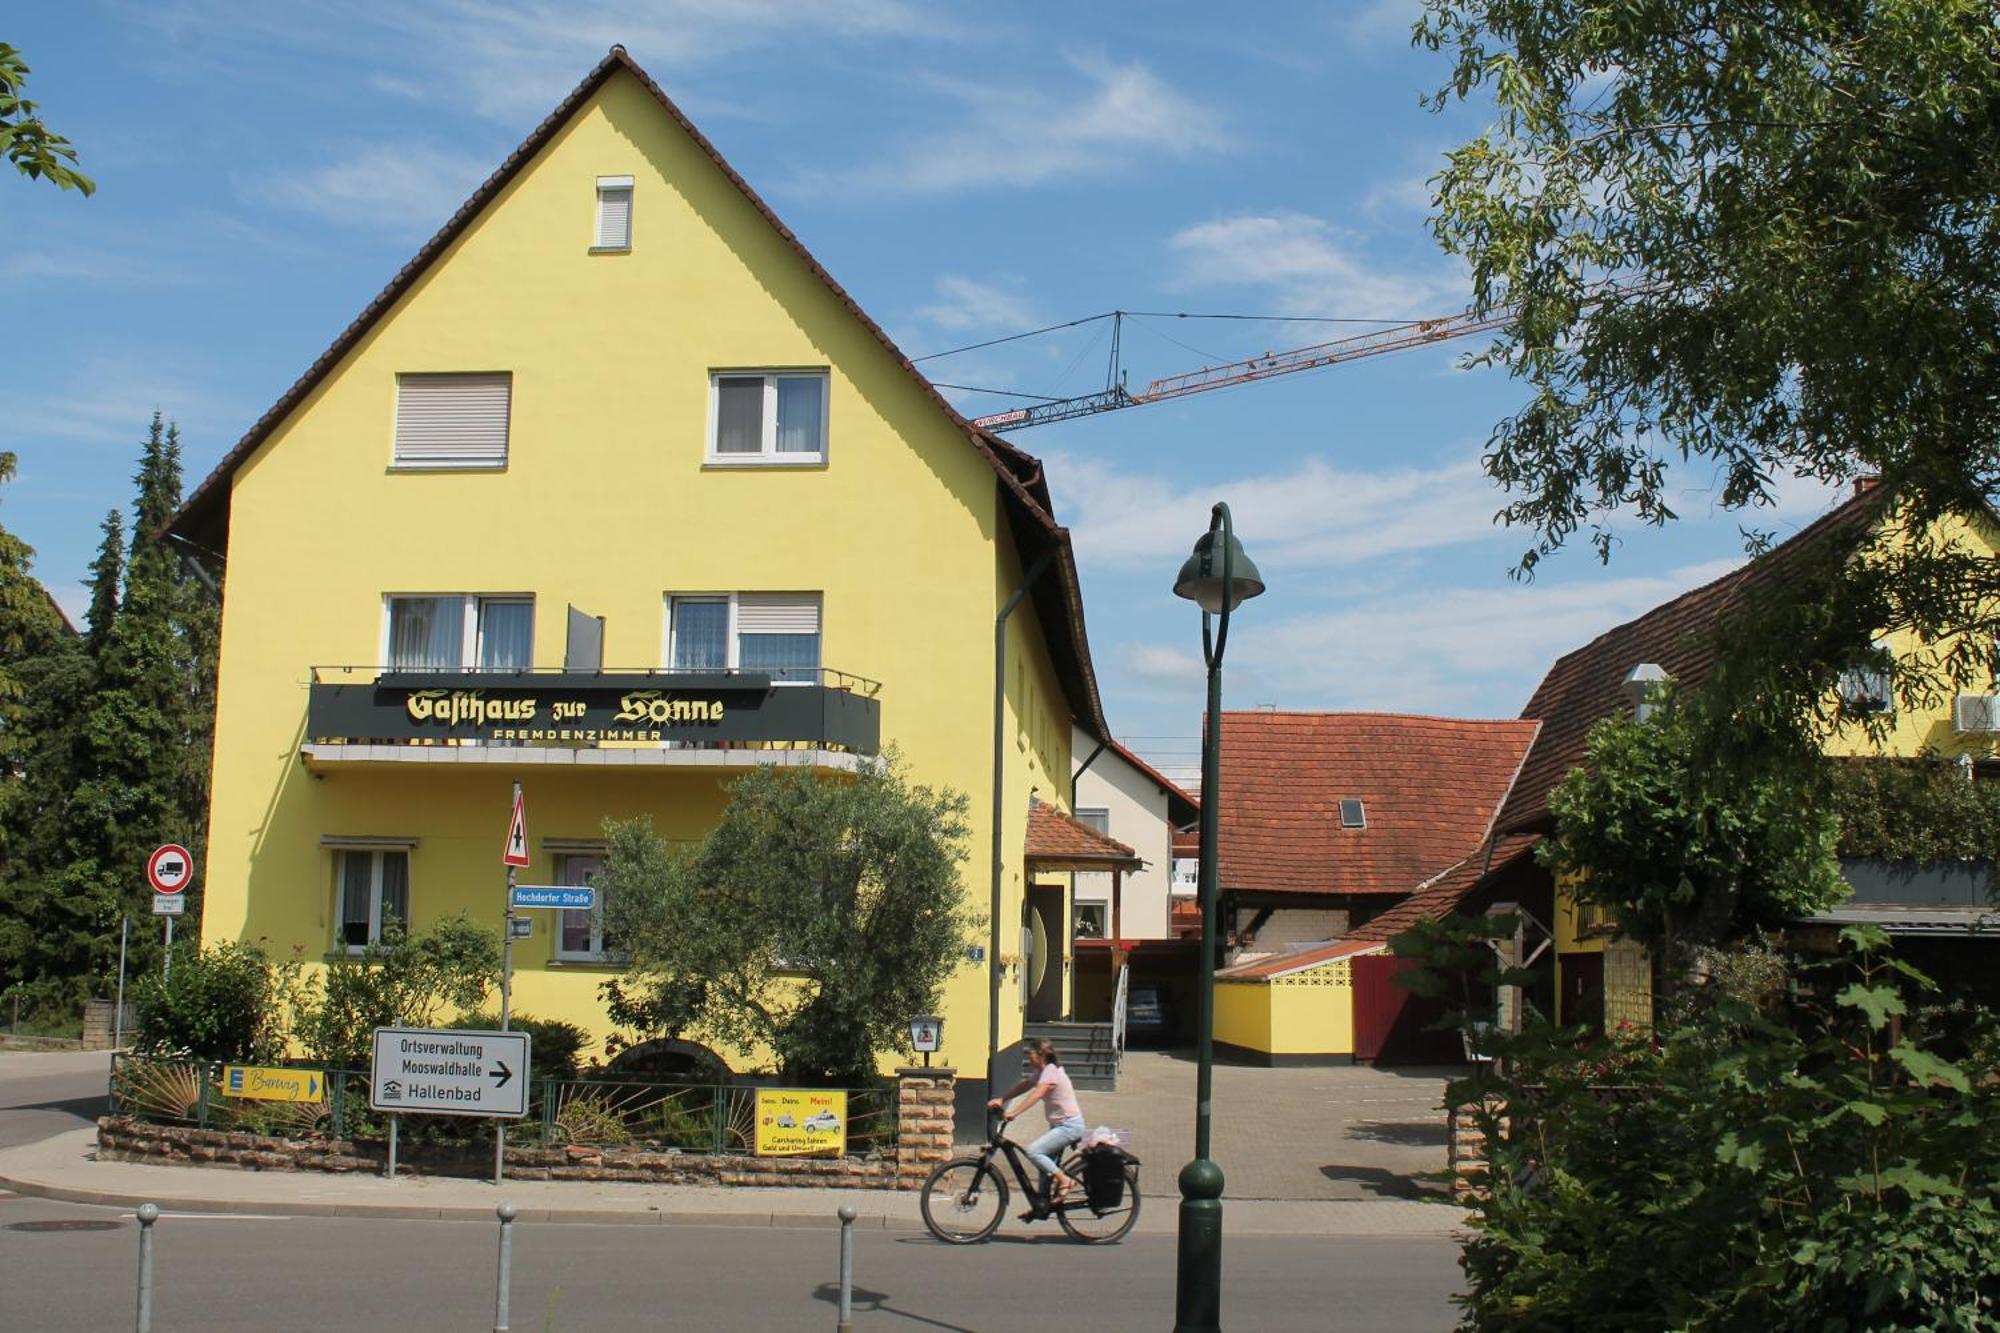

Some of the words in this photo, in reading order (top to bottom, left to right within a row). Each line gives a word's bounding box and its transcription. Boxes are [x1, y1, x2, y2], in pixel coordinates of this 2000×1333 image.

[552, 701, 587, 721] zur
[613, 689, 724, 724] Sonne
[493, 730, 661, 741] FREMDENZIMMER
[516, 891, 560, 903] Hochdorfer
[563, 892, 589, 904] Straße
[400, 1039, 483, 1060] Ortsverwaltung
[402, 1060, 482, 1077] Mooswaldhalle
[408, 1084, 481, 1101] Hallenbad
